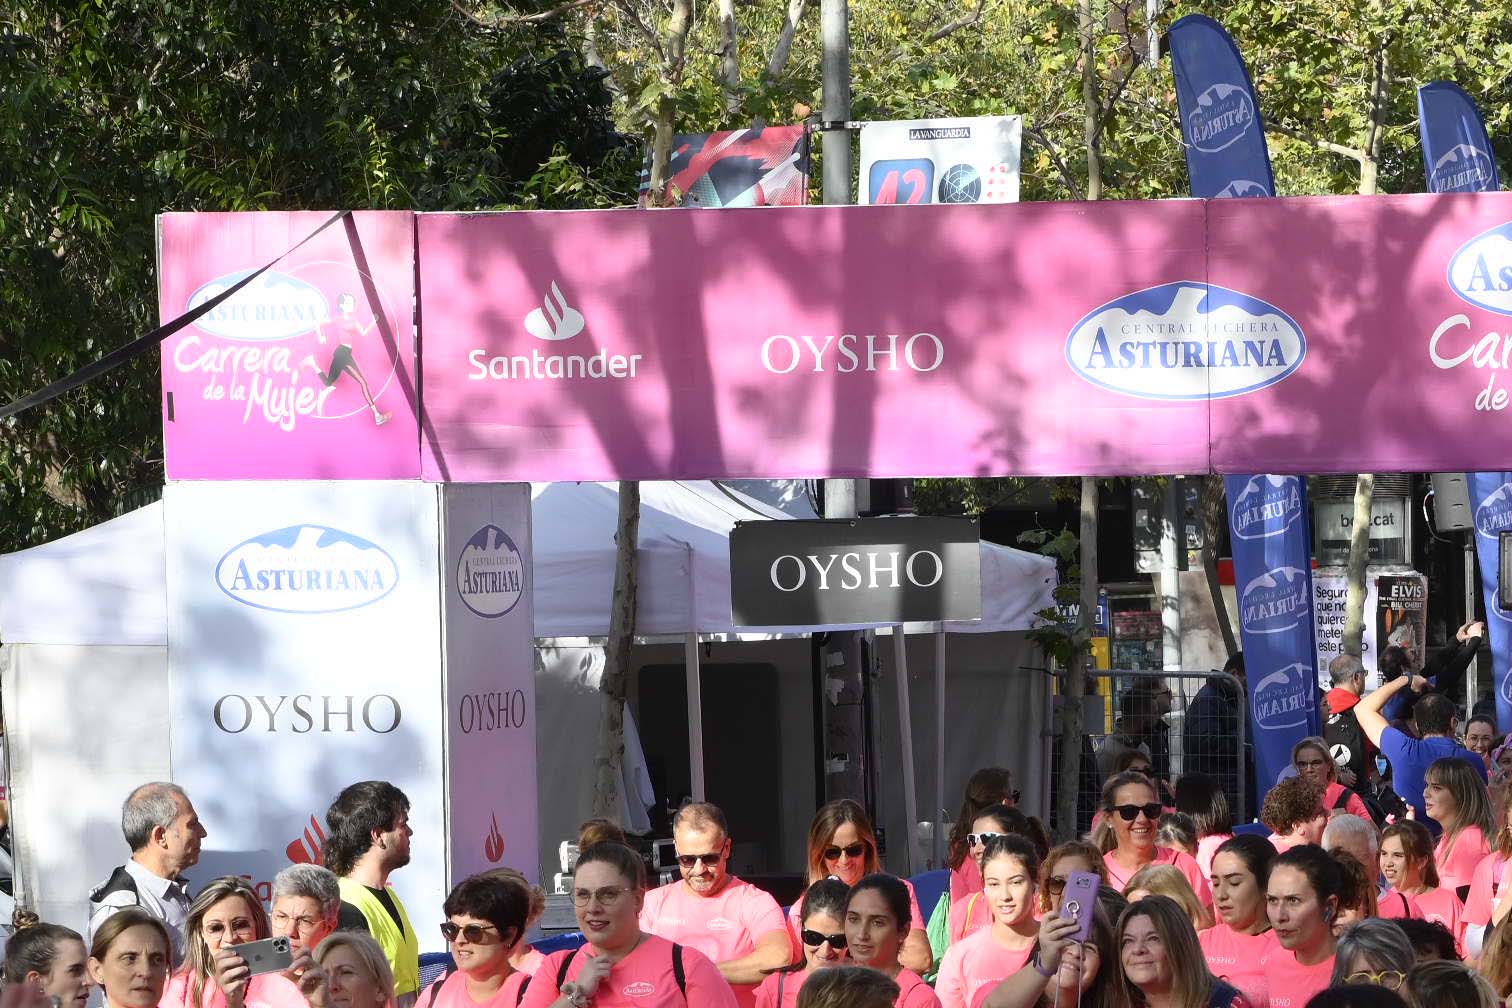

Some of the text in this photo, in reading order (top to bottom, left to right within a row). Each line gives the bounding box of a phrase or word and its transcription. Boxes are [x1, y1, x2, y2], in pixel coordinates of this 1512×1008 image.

[174, 336, 293, 375] Carrera
[467, 348, 643, 380] Santander
[760, 332, 945, 374] OYSHO
[1086, 327, 1288, 369] ASTURIANA
[202, 365, 335, 432] de la Mujer
[1474, 373, 1508, 412] de
[230, 557, 386, 592] ASTURIANA
[461, 562, 521, 595] ASTURIANA
[770, 550, 944, 592] OYSHO
[1317, 603, 1333, 614] que
[1391, 585, 1422, 598] ELVIS
[212, 693, 403, 734] OYSHO
[458, 688, 527, 734] OYSHO
